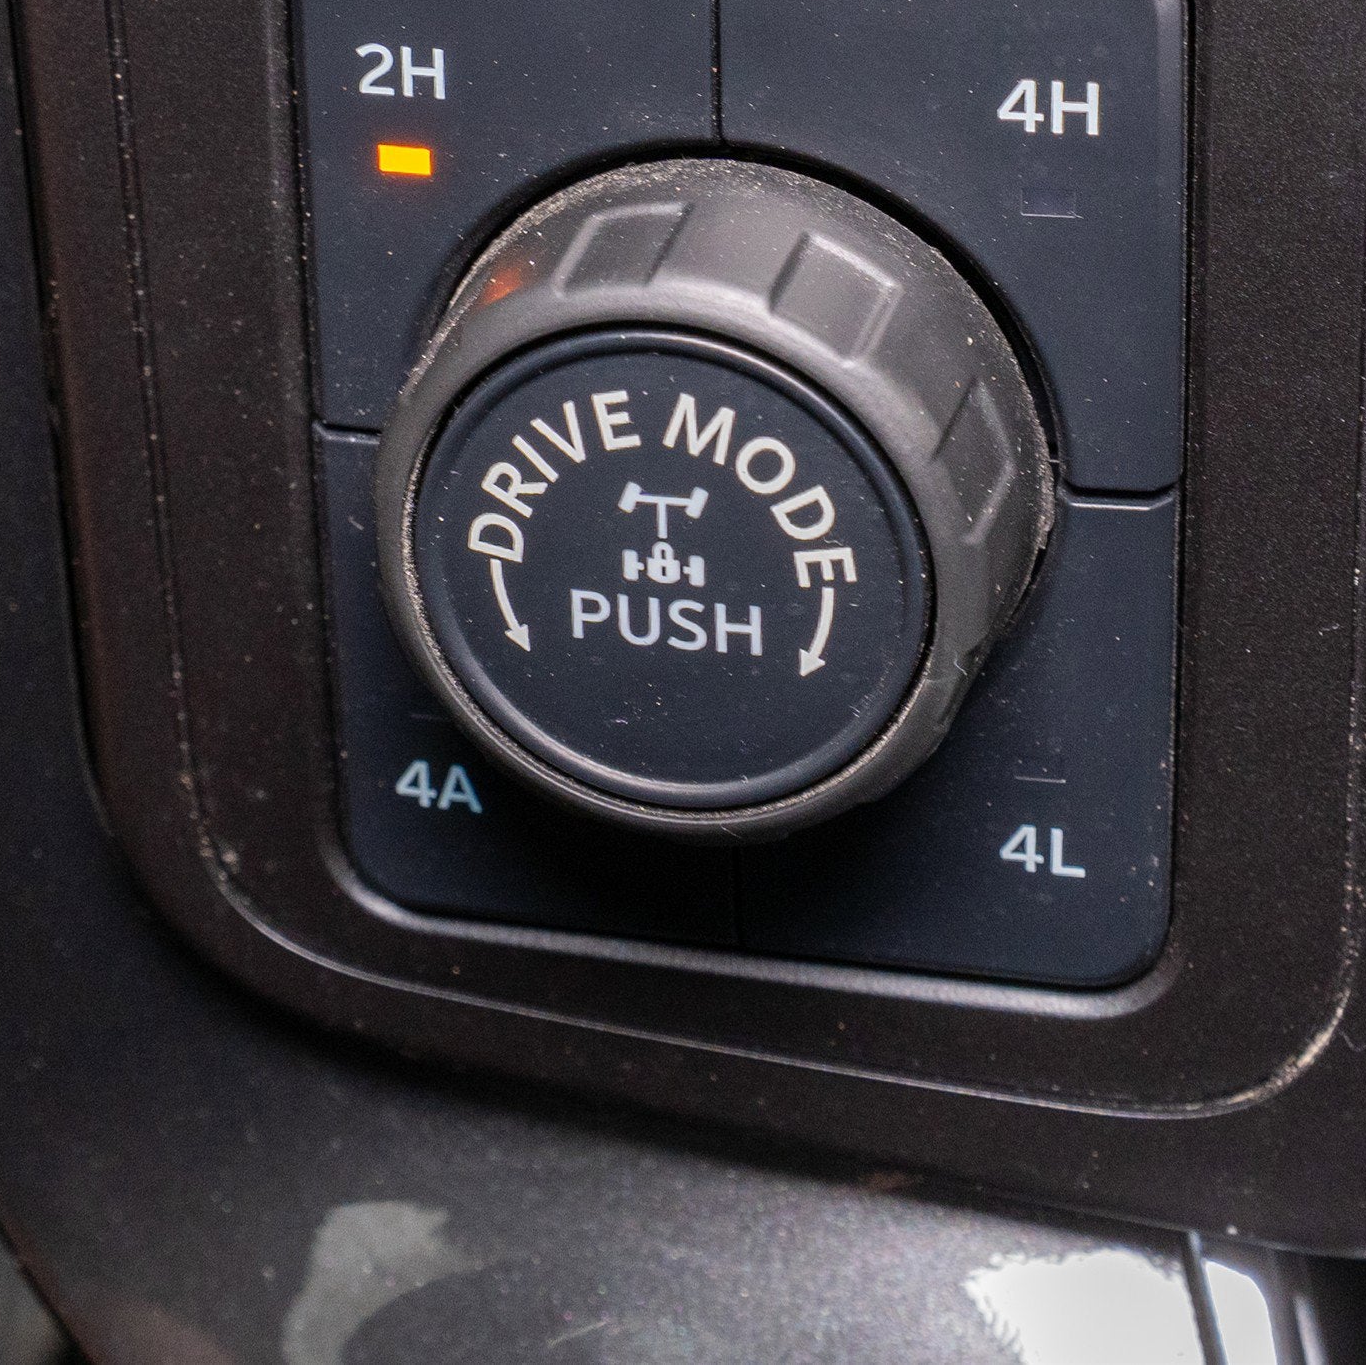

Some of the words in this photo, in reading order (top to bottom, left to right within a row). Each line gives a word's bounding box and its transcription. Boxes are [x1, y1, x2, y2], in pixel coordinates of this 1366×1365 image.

[354, 41, 448, 101] 2H
[995, 77, 1102, 137] 4H
[467, 390, 642, 564] DRIVE
[662, 392, 857, 589] MODE
[569, 587, 764, 657] PUSH
[393, 759, 484, 815] 4A
[998, 823, 1088, 880] 4L
